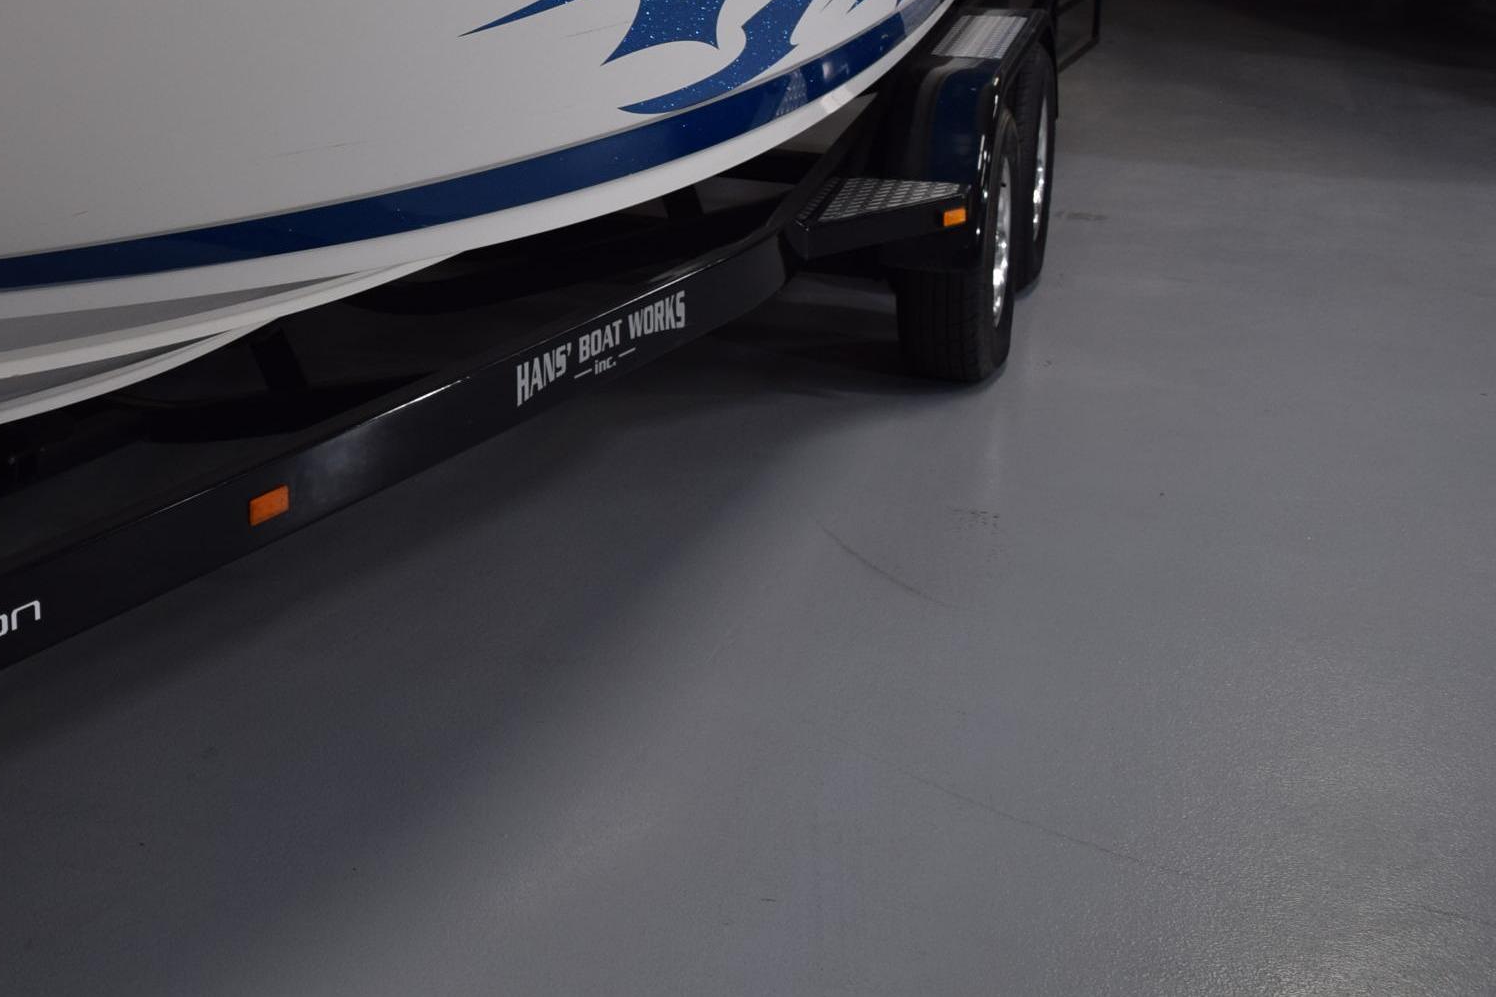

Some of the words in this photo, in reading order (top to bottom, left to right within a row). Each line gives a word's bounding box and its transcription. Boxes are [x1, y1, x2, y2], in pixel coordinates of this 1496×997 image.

[516, 342, 572, 408] HANS'
[578, 319, 623, 364] BOAT
[627, 289, 686, 340] WORKS
